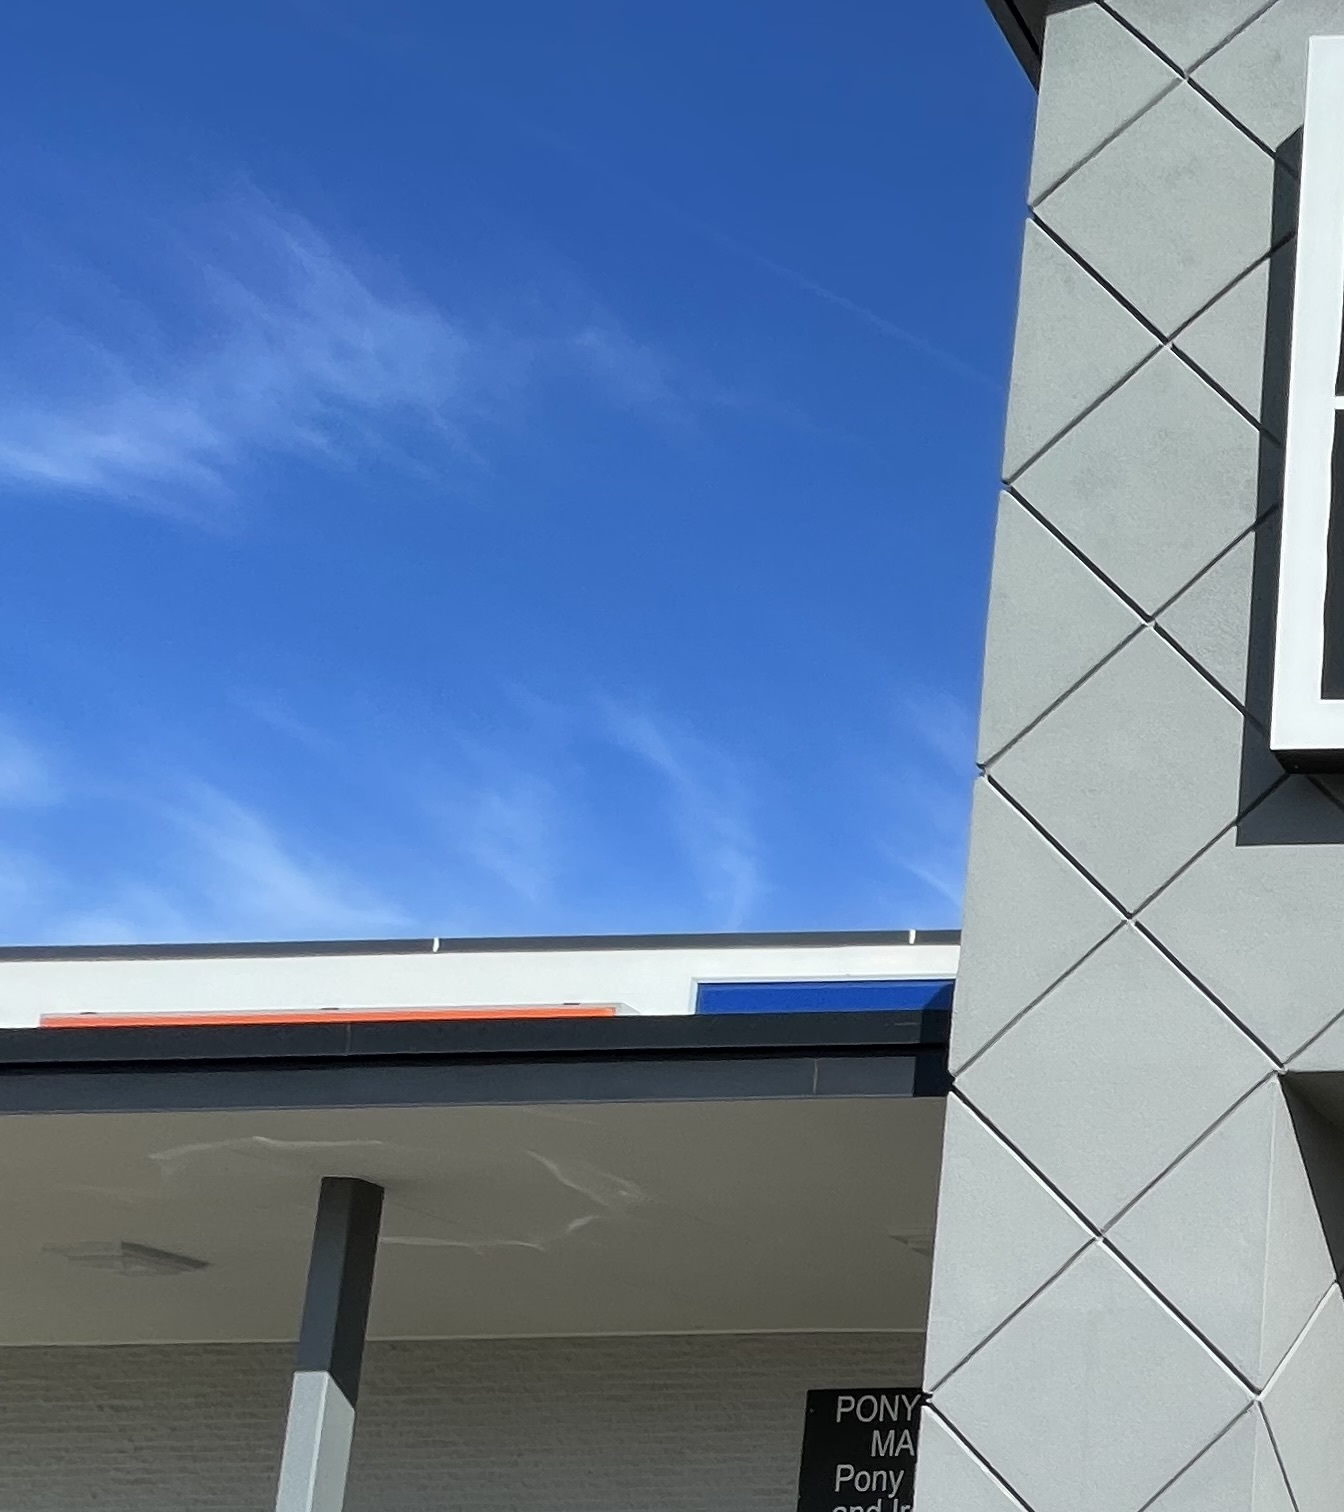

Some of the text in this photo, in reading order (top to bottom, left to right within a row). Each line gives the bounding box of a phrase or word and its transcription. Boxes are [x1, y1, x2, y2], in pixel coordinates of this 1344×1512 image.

[836, 1395, 920, 1422] PONY
[871, 1429, 915, 1457] MA
[834, 1464, 904, 1498] Pony
